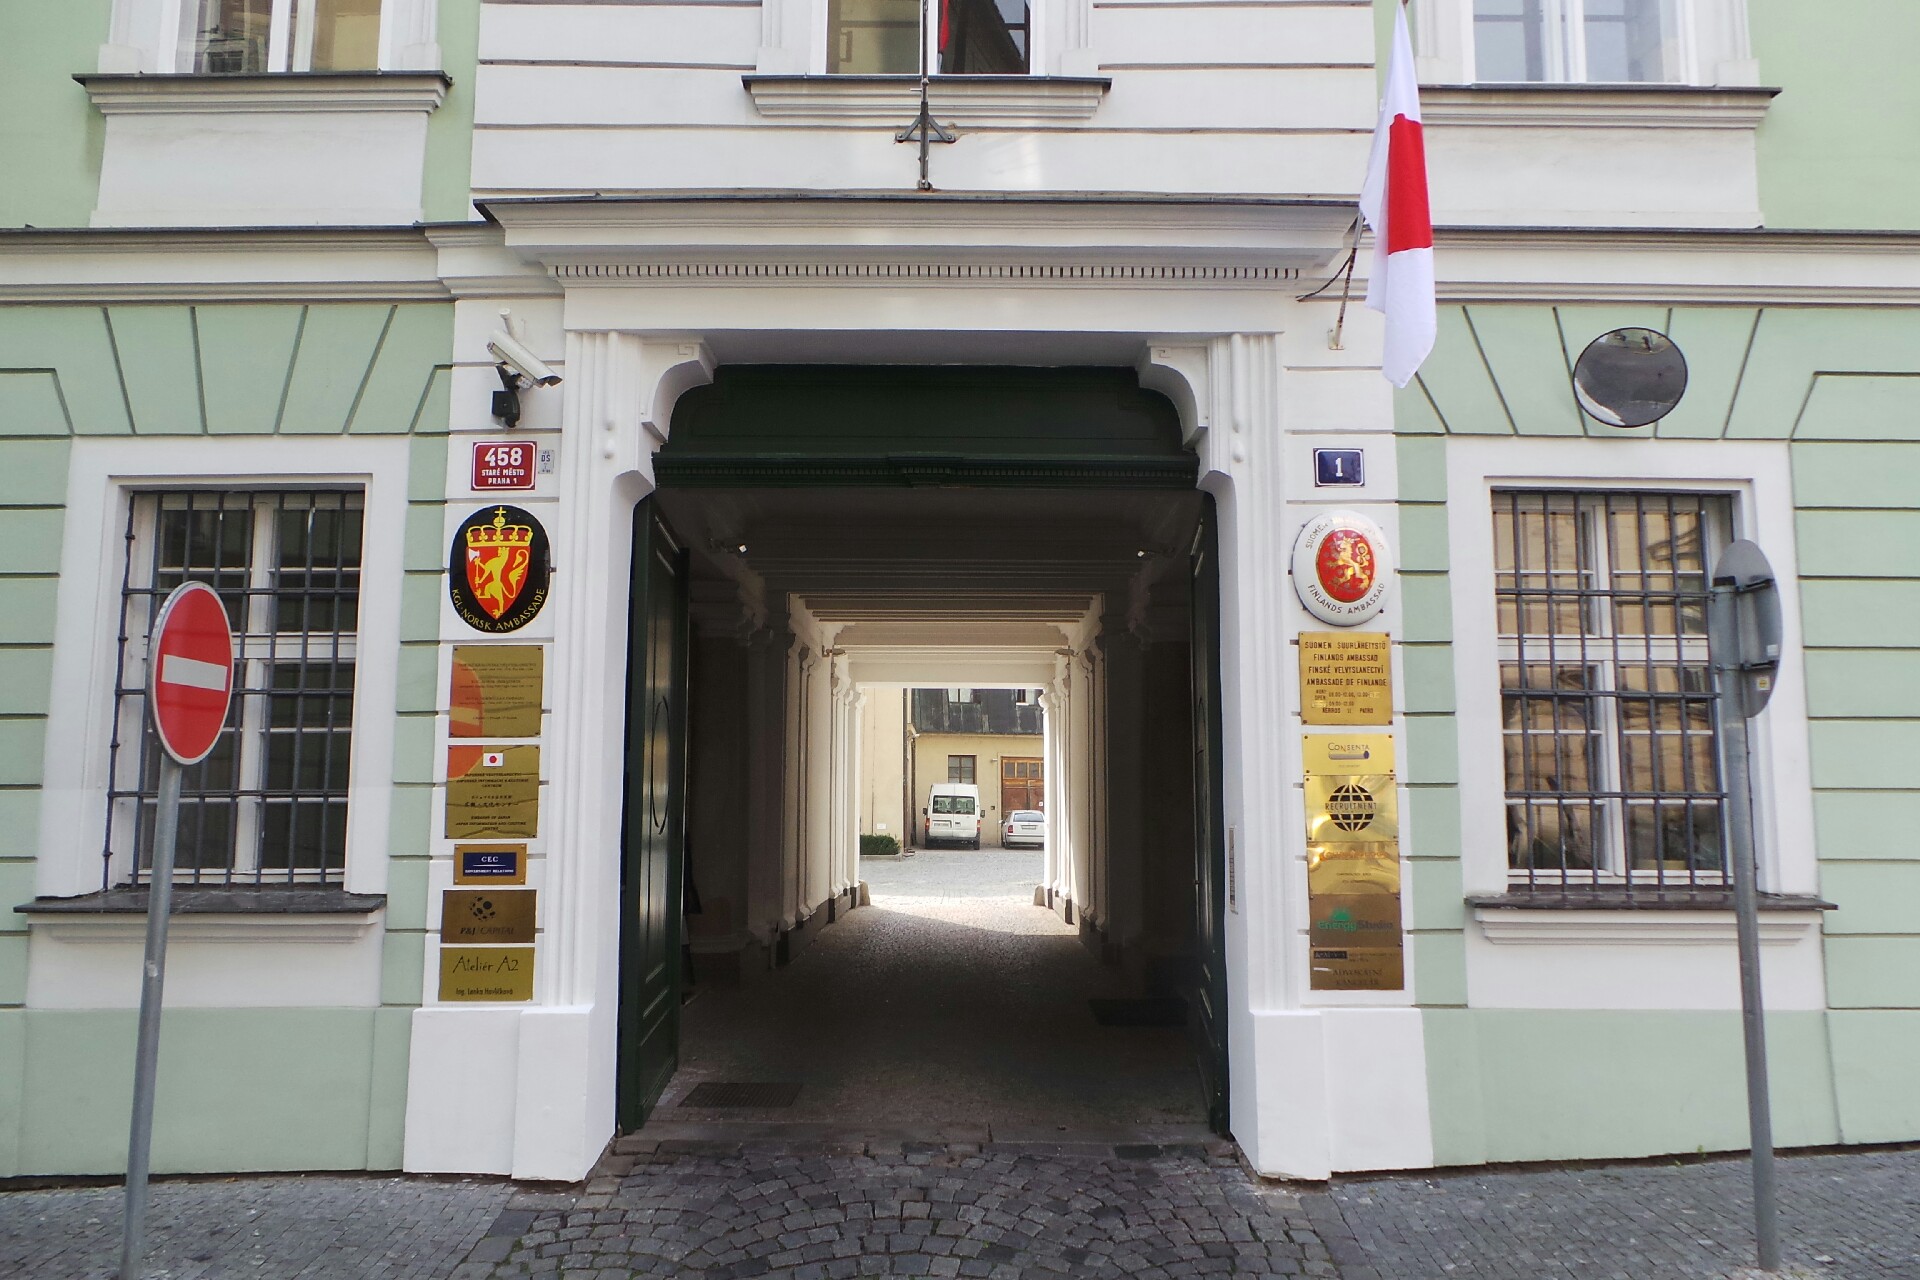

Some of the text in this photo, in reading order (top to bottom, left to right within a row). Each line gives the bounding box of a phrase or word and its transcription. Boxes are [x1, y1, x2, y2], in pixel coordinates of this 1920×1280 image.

[484, 448, 523, 466] 458
[482, 468, 500, 476] STARÉ
[1335, 457, 1343, 477] 1
[1307, 582, 1386, 614] FINLANDS AMBASSAD
[461, 607, 492, 631] NORSK
[495, 588, 545, 631] AMBASSADE
[1337, 640, 1386, 650] SUURLÄHETYSTÖ
[1308, 665, 1384, 673] FINSKÉ VELVYSLANECTVÍ
[1357, 678, 1387, 686] FINLANDE
[496, 955, 519, 973] A2
